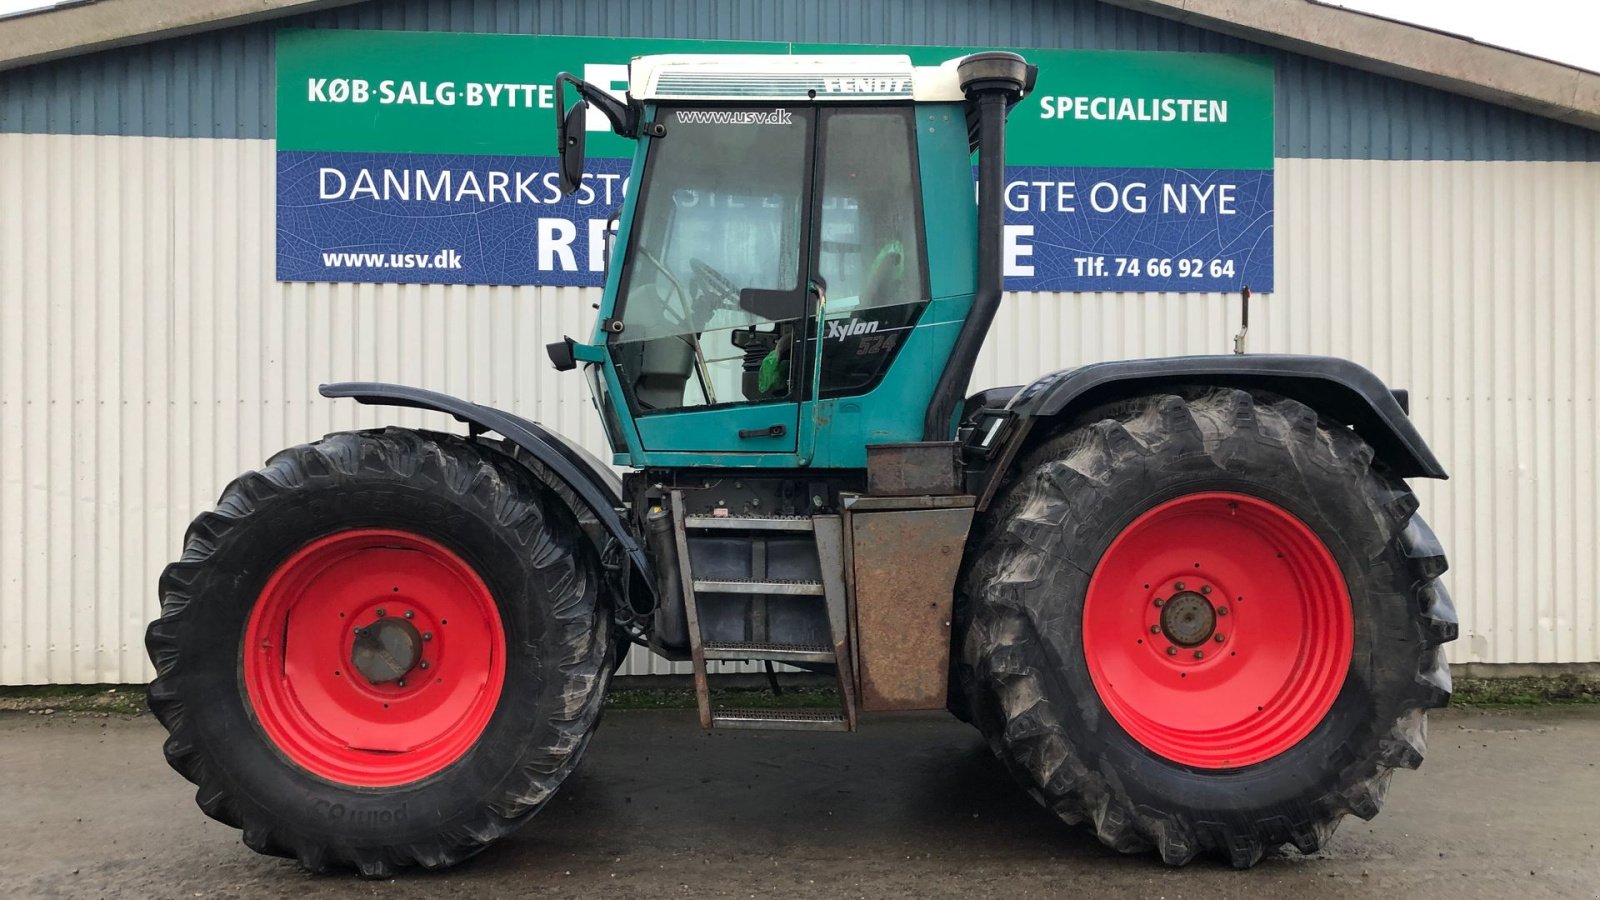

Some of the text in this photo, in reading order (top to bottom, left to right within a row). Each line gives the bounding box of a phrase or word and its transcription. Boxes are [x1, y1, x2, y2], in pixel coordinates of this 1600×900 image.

[823, 78, 911, 92] FENDT
[676, 108, 793, 125] www.usv.dk
[1040, 95, 1228, 123] SPECIALISTEN
[319, 167, 562, 204] DANMARKS
[1090, 181, 1147, 214] OG
[1163, 183, 1236, 215] NYE
[322, 249, 1236, 278] www.usv.dk Tlf. 74 66 92 64
[828, 318, 879, 342] Xylon
[857, 334, 899, 355] 524
